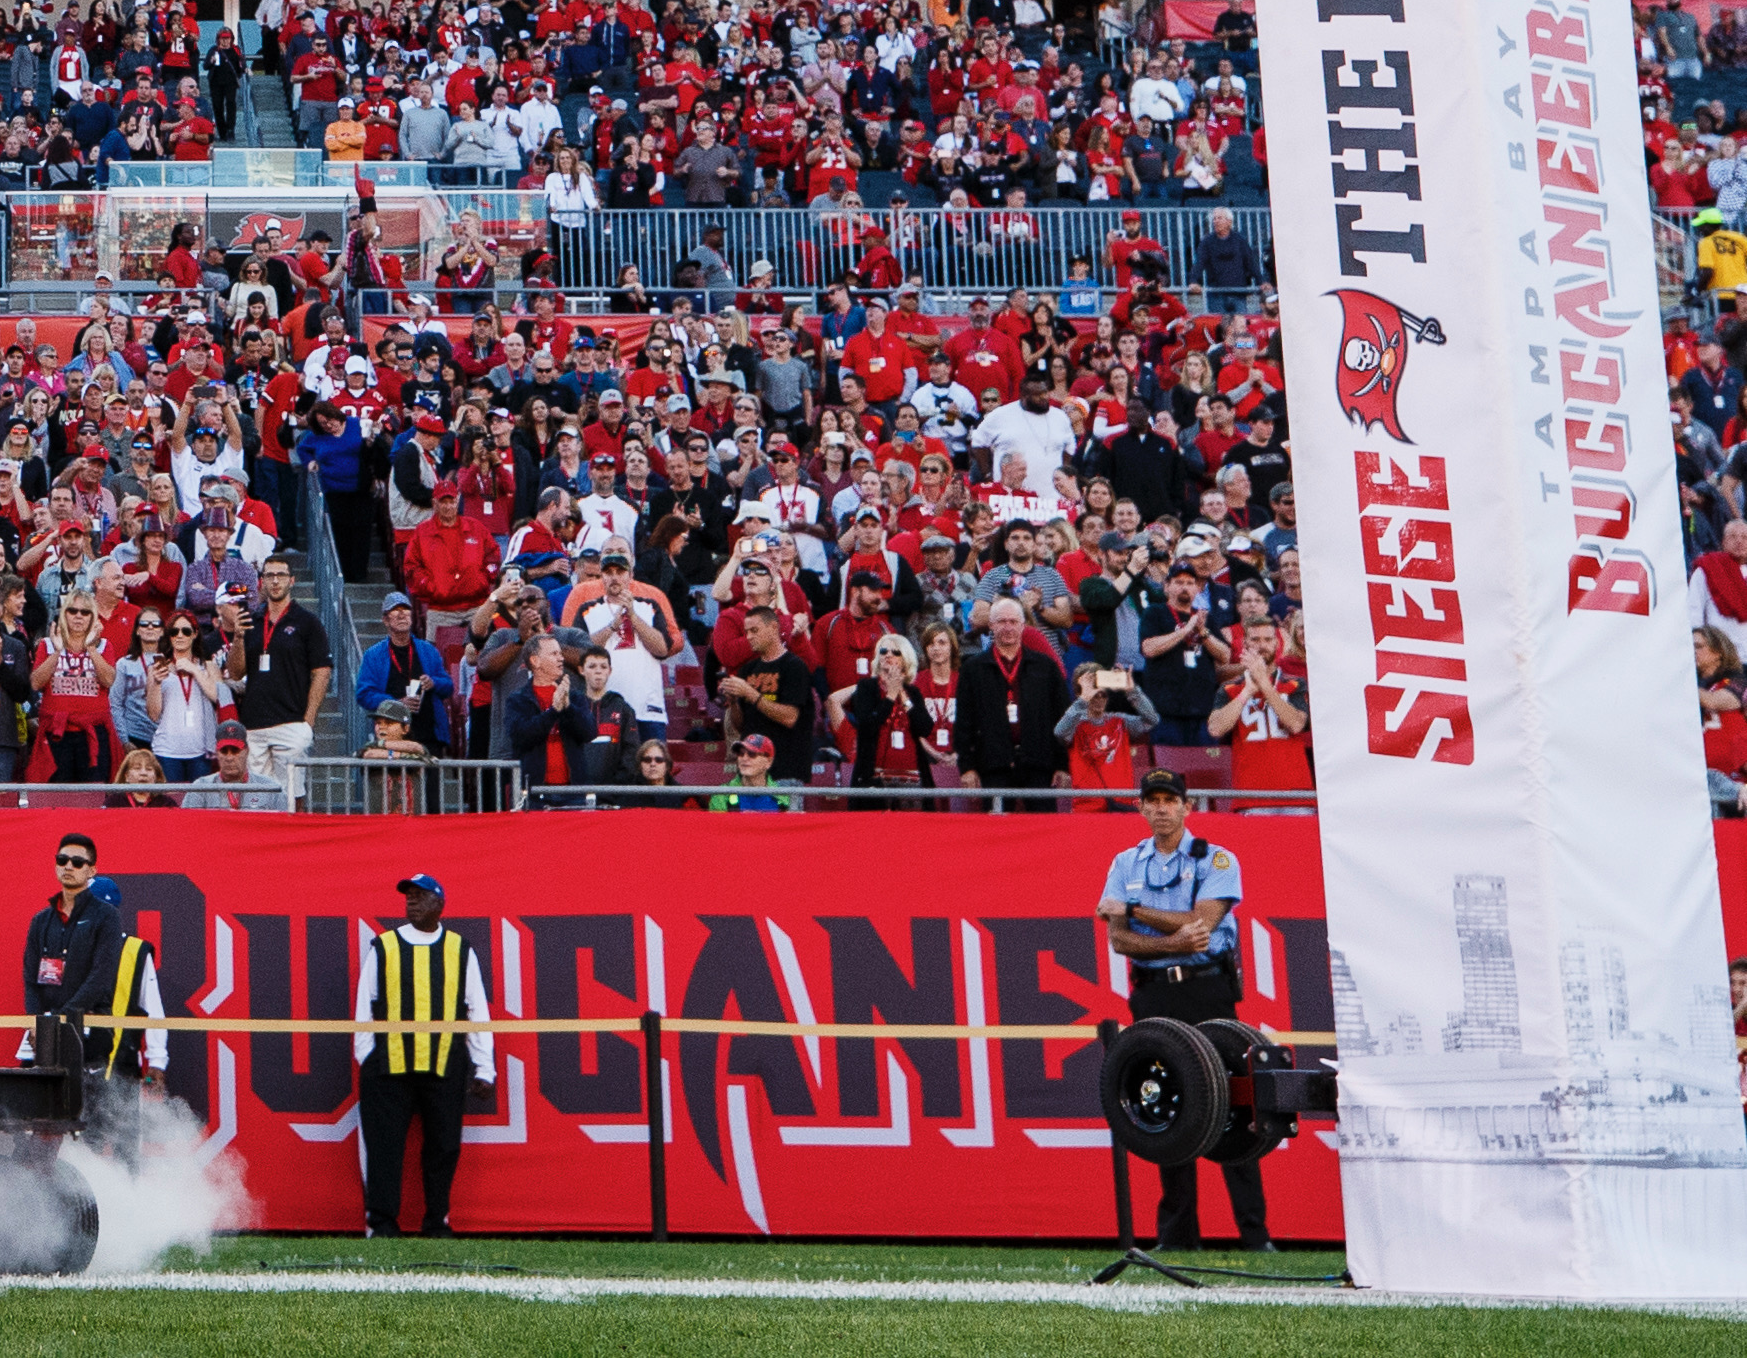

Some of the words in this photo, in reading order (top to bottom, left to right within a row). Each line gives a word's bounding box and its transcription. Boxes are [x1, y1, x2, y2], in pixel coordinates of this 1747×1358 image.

[1321, 50, 1428, 277] THE
[1496, 25, 1528, 172] BAY
[1521, 229, 1562, 503] TAMPA
[1354, 451, 1476, 767] SIEGE
